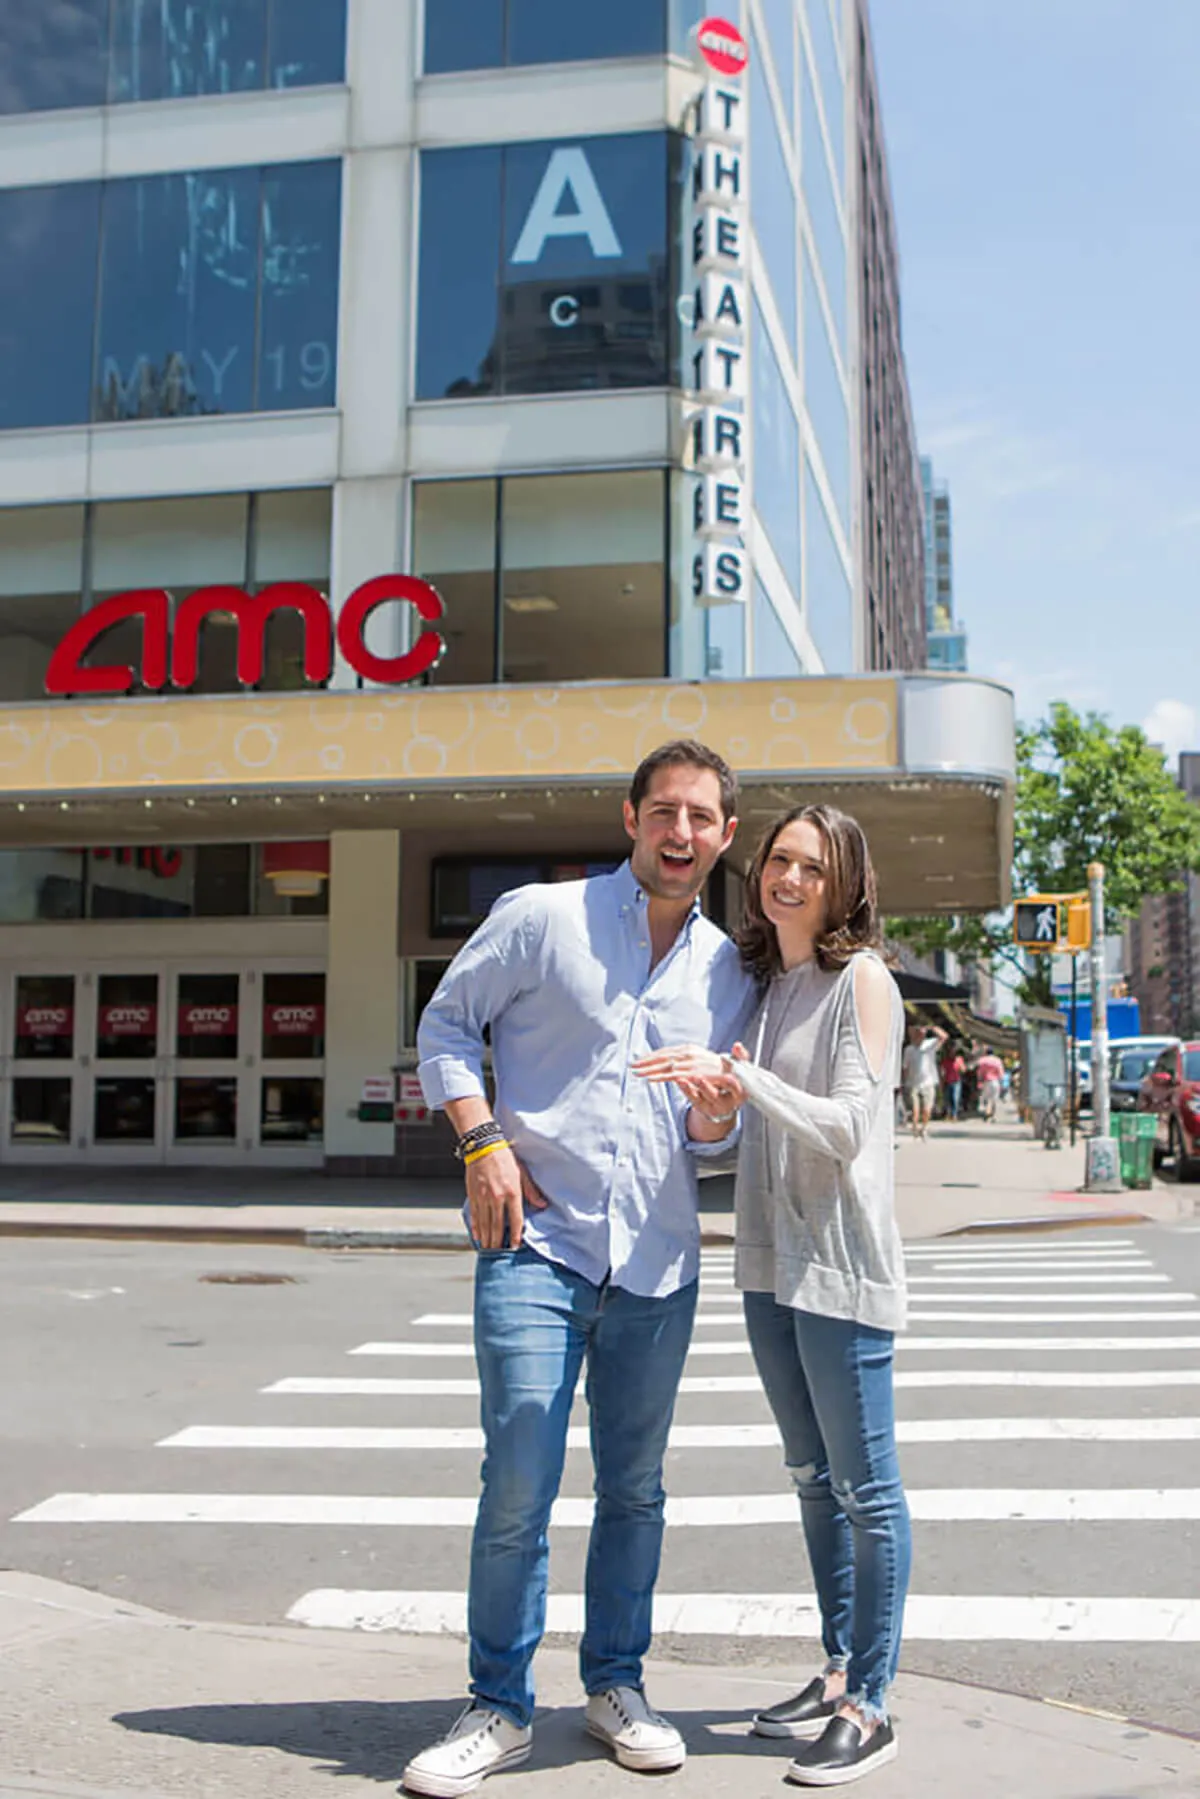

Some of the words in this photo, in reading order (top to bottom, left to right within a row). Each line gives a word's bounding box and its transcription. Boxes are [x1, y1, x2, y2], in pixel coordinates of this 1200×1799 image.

[701, 31, 746, 61] amc
[511, 146, 623, 264] A
[102, 346, 239, 403] MAY
[265, 341, 331, 391] 19
[715, 89, 742, 593] THEATRES
[45, 573, 446, 694] amc
